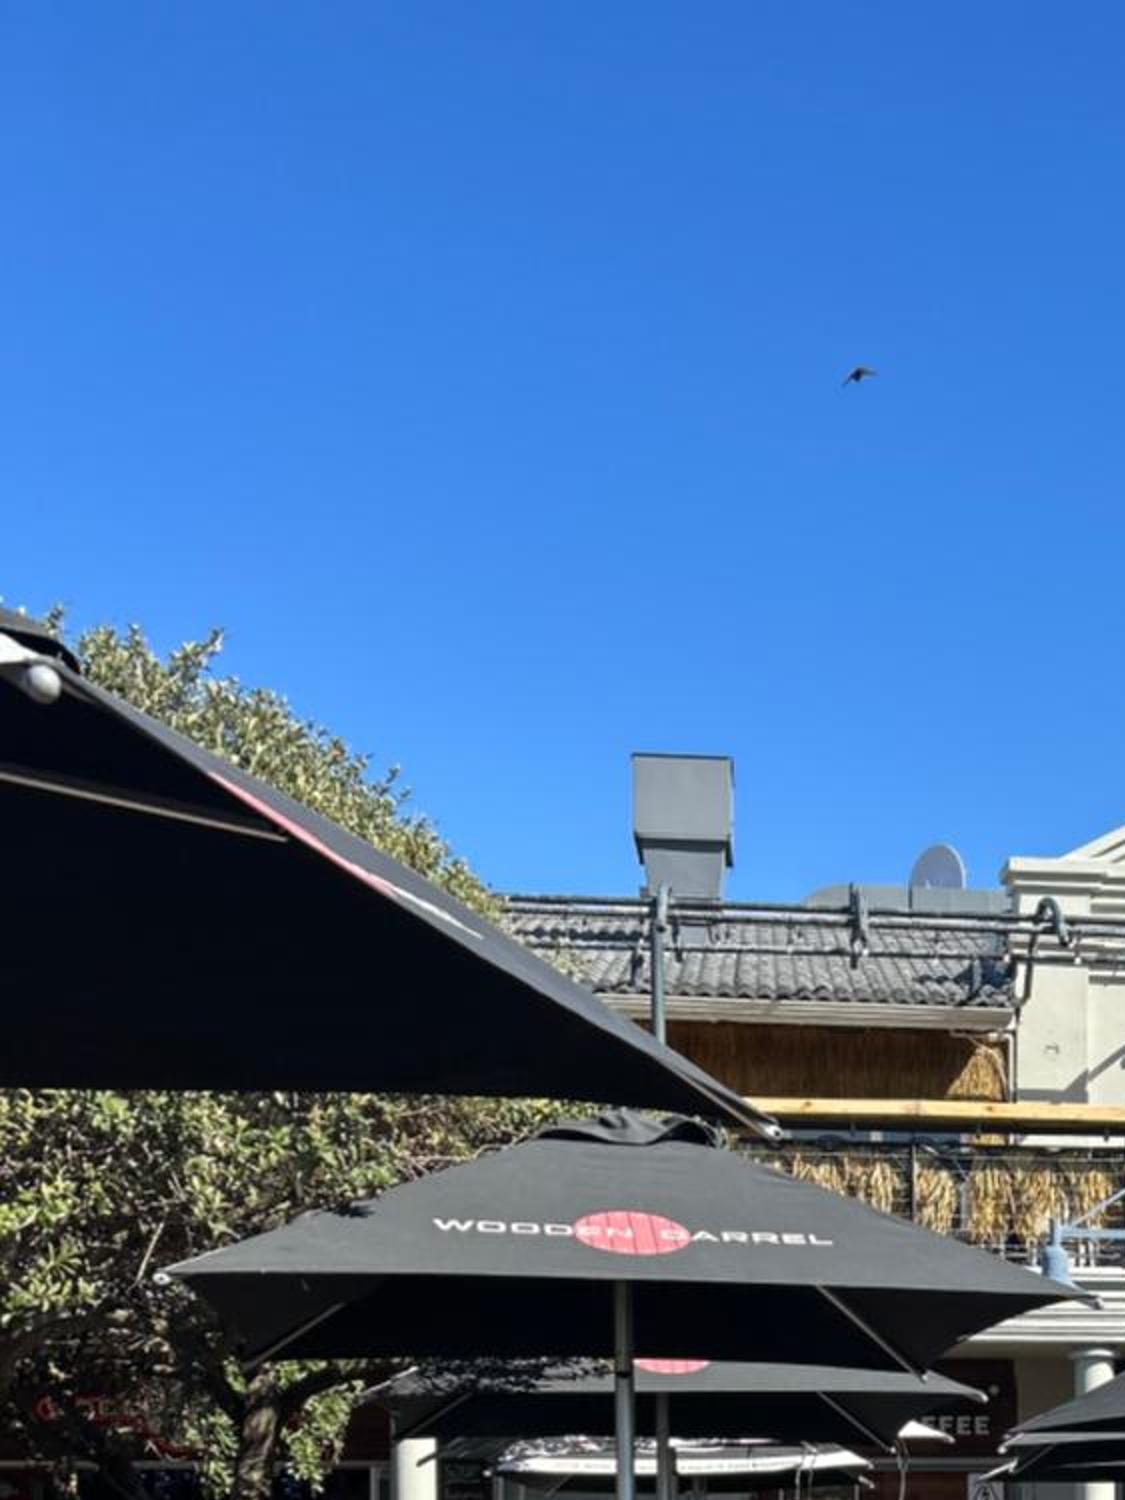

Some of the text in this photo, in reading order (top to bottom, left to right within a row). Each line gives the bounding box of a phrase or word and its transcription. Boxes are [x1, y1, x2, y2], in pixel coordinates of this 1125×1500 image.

[432, 1217, 834, 1246] WOODEN BARREL
[921, 1415, 991, 1436] FFEE
